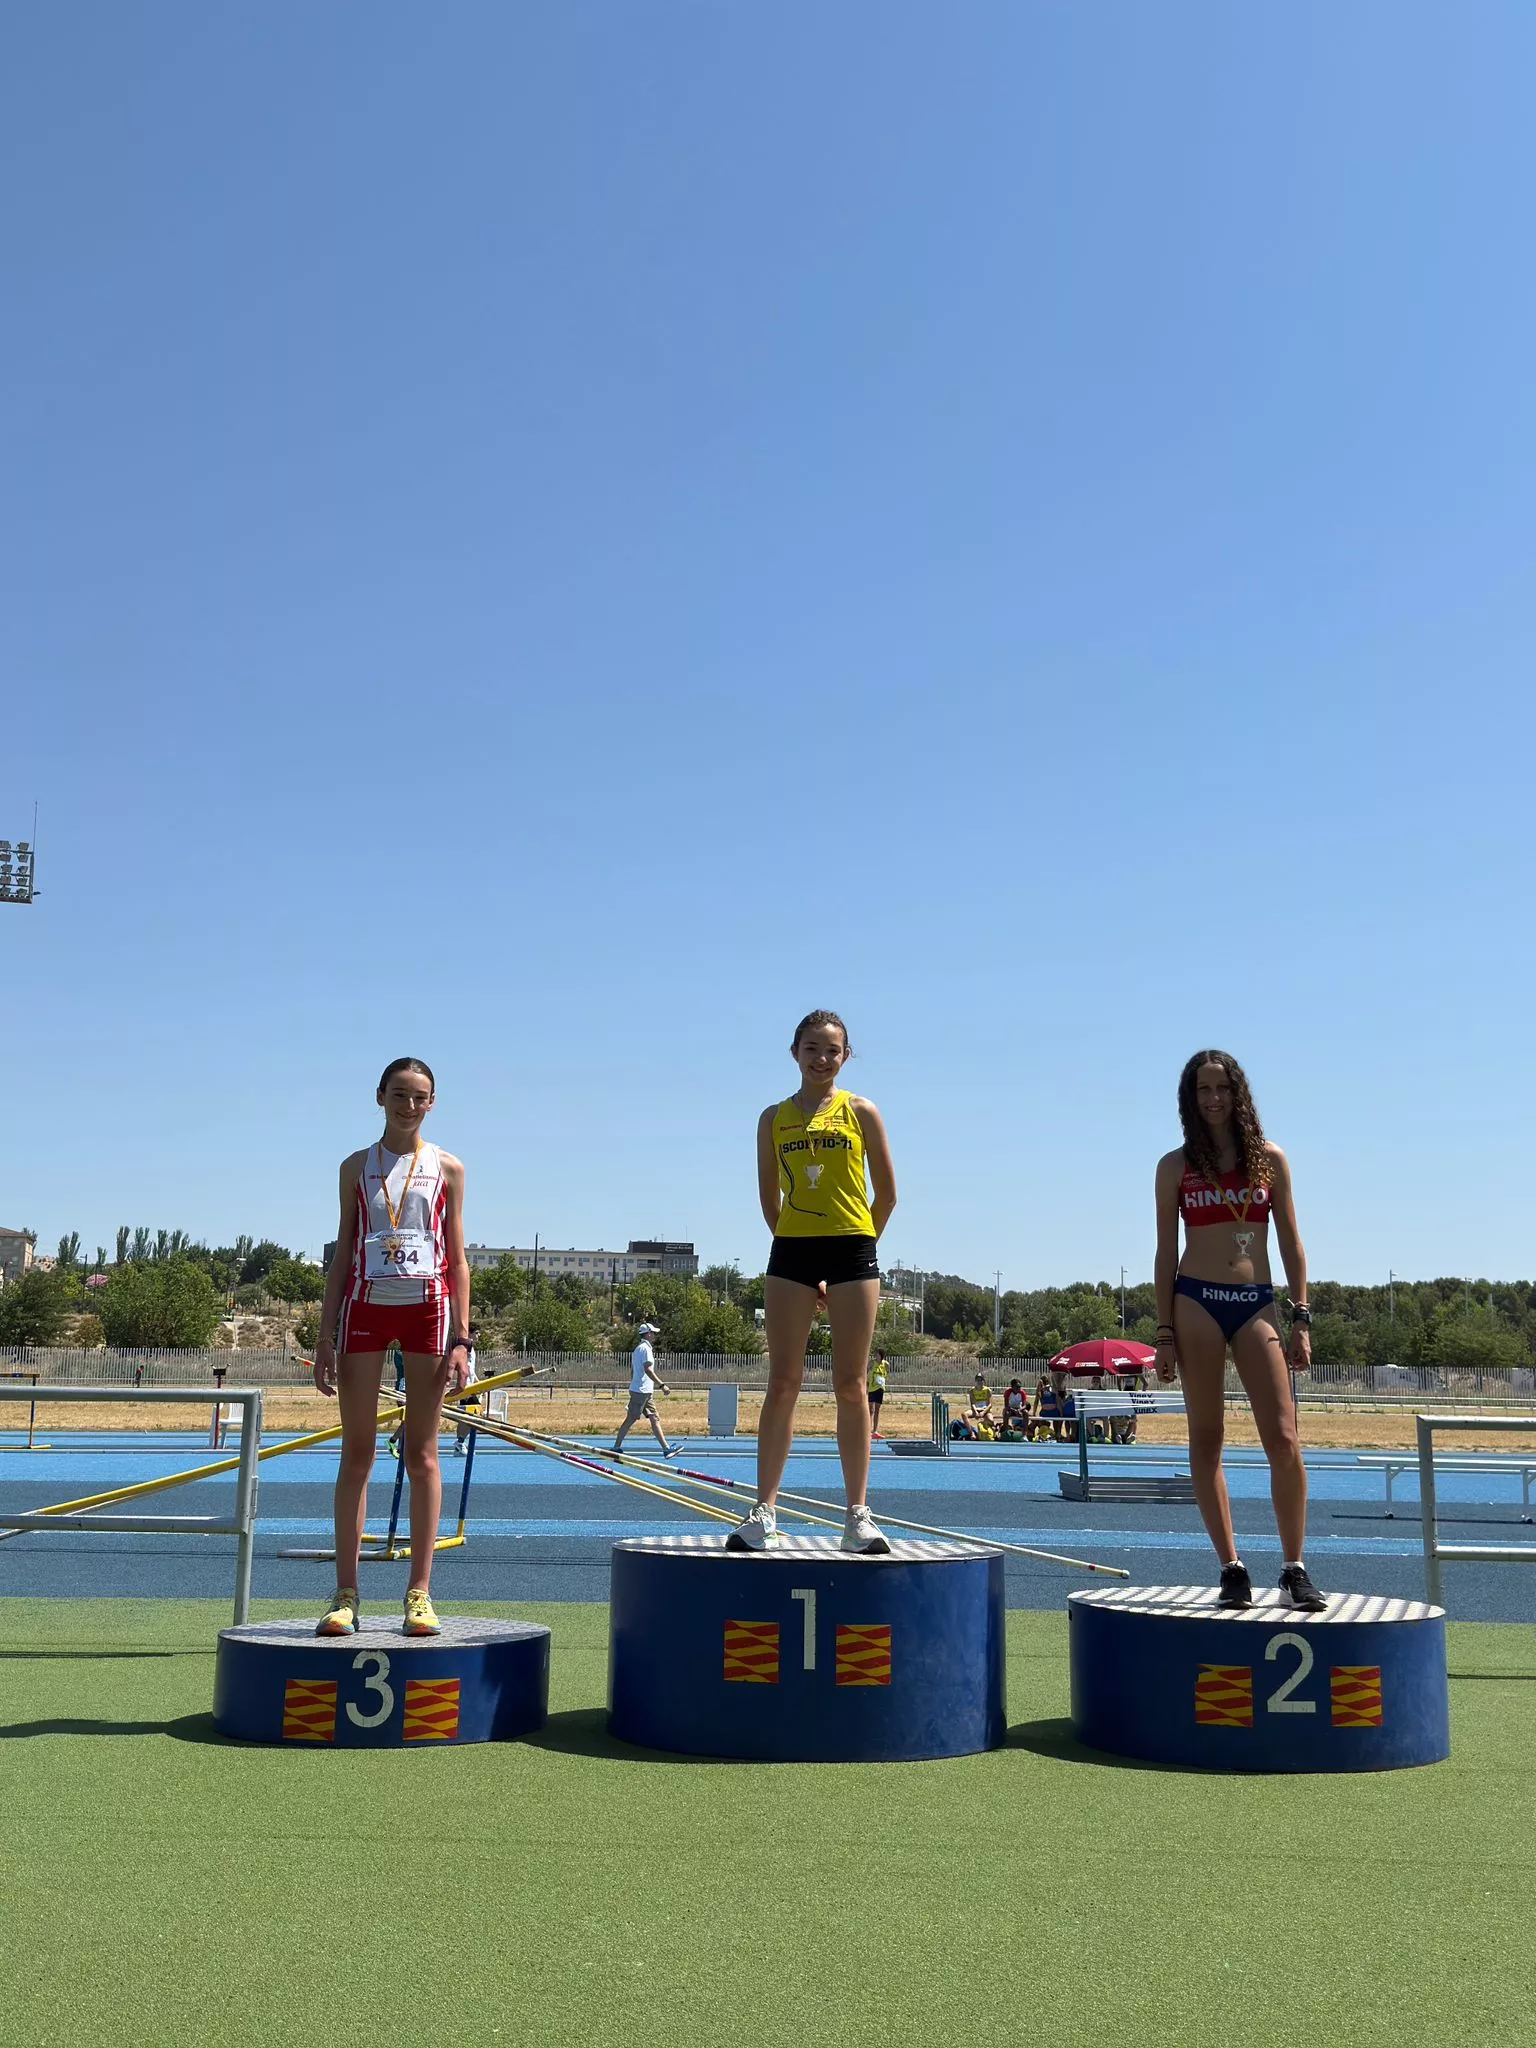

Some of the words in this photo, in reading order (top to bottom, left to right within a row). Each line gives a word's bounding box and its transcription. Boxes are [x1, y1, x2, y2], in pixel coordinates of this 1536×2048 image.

[1185, 1188, 1267, 1208] HINACO
[381, 1249, 419, 1266] 794
[1202, 1287, 1259, 1302] HINACO
[791, 1588, 816, 1670] 1
[346, 1650, 394, 1728] 3
[1264, 1632, 1316, 1713] 2
